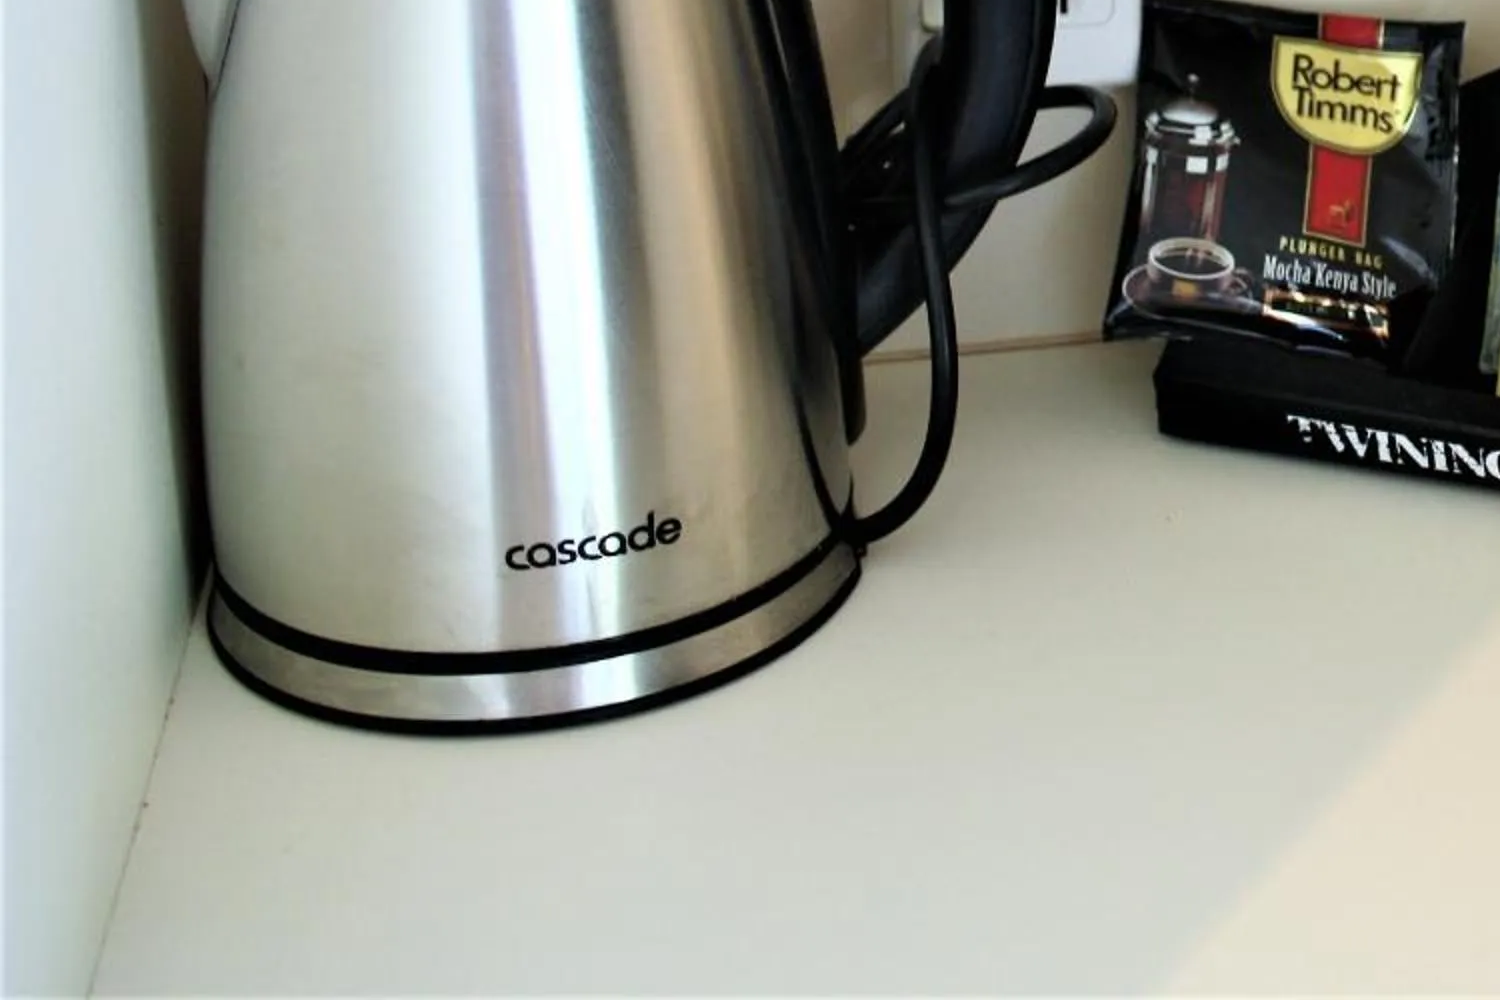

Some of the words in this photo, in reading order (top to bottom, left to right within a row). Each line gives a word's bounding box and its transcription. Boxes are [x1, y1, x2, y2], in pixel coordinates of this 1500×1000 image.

[1292, 53, 1401, 103] Robert
[1292, 86, 1394, 135] Timms
[1263, 253, 1312, 286] Mocha
[1315, 262, 1360, 295] Kenya
[1361, 271, 1397, 300] Style
[1279, 235, 1346, 262] PLUNGER
[1355, 250, 1383, 270] BAG
[505, 510, 682, 570] cascade
